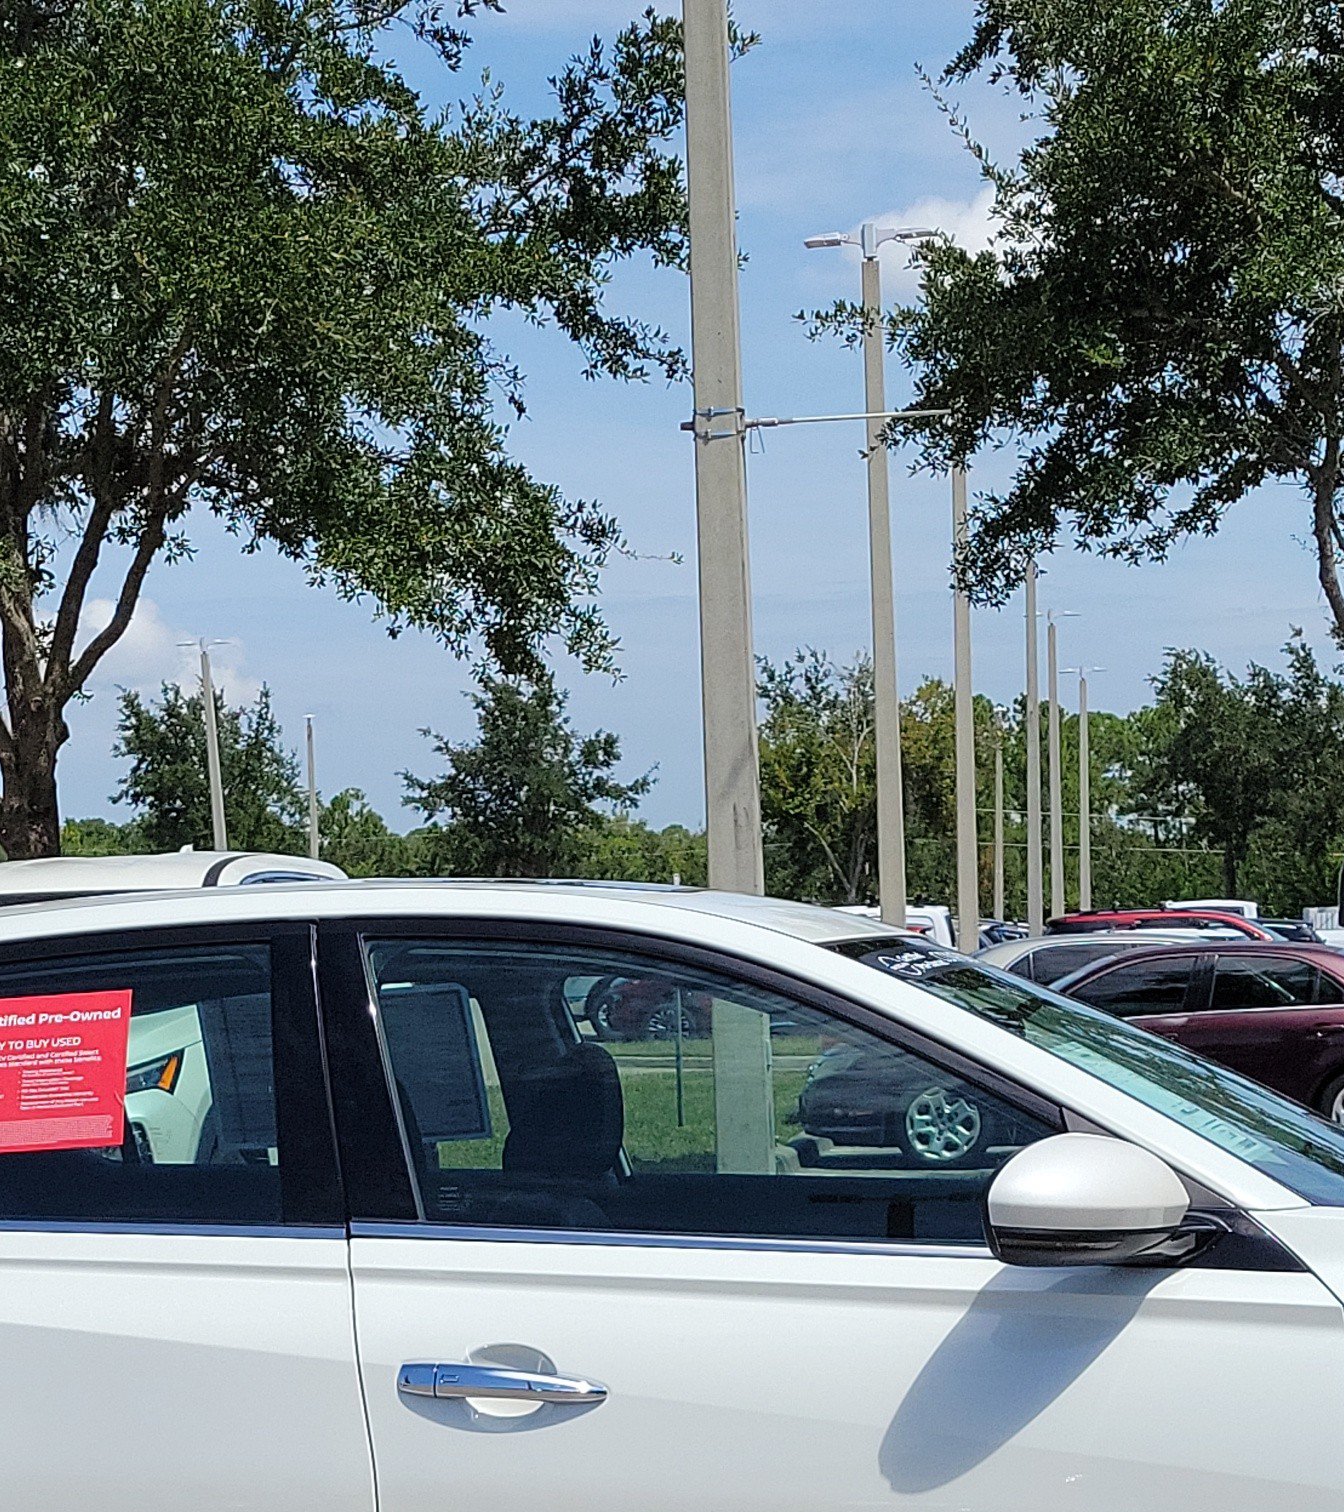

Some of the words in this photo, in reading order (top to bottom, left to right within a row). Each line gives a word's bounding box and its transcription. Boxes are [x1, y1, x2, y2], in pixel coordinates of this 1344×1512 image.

[39, 1007, 122, 1025] Pre-Owned
[8, 1040, 24, 1050] TO
[26, 1038, 51, 1049] BUY
[51, 1036, 82, 1047] USED
